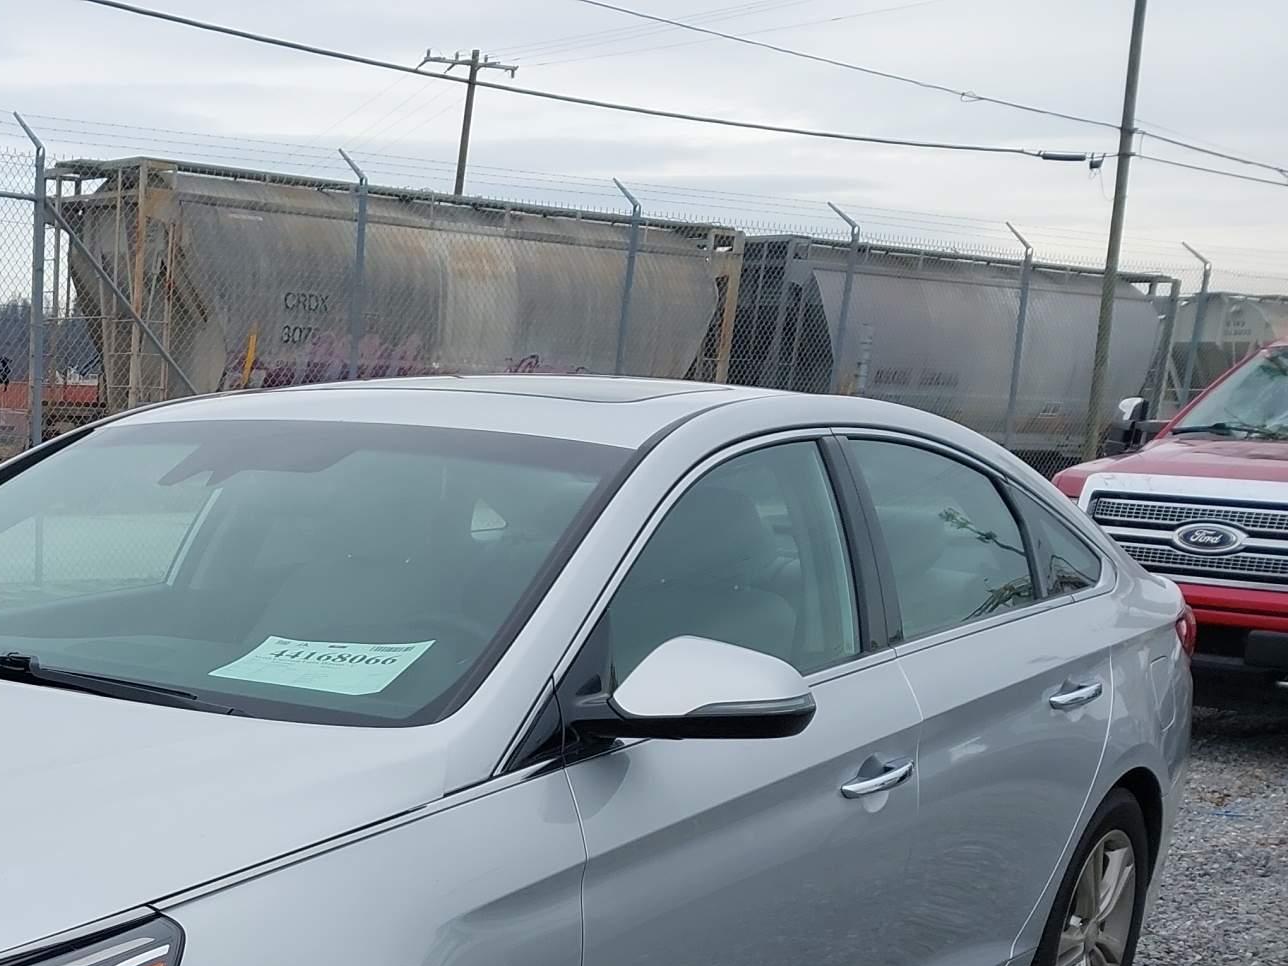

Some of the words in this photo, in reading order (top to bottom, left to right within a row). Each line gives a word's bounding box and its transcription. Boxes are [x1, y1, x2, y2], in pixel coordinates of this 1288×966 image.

[284, 292, 329, 313] CRDX
[1190, 529, 1224, 544] Ford
[272, 649, 398, 665] 44168066
